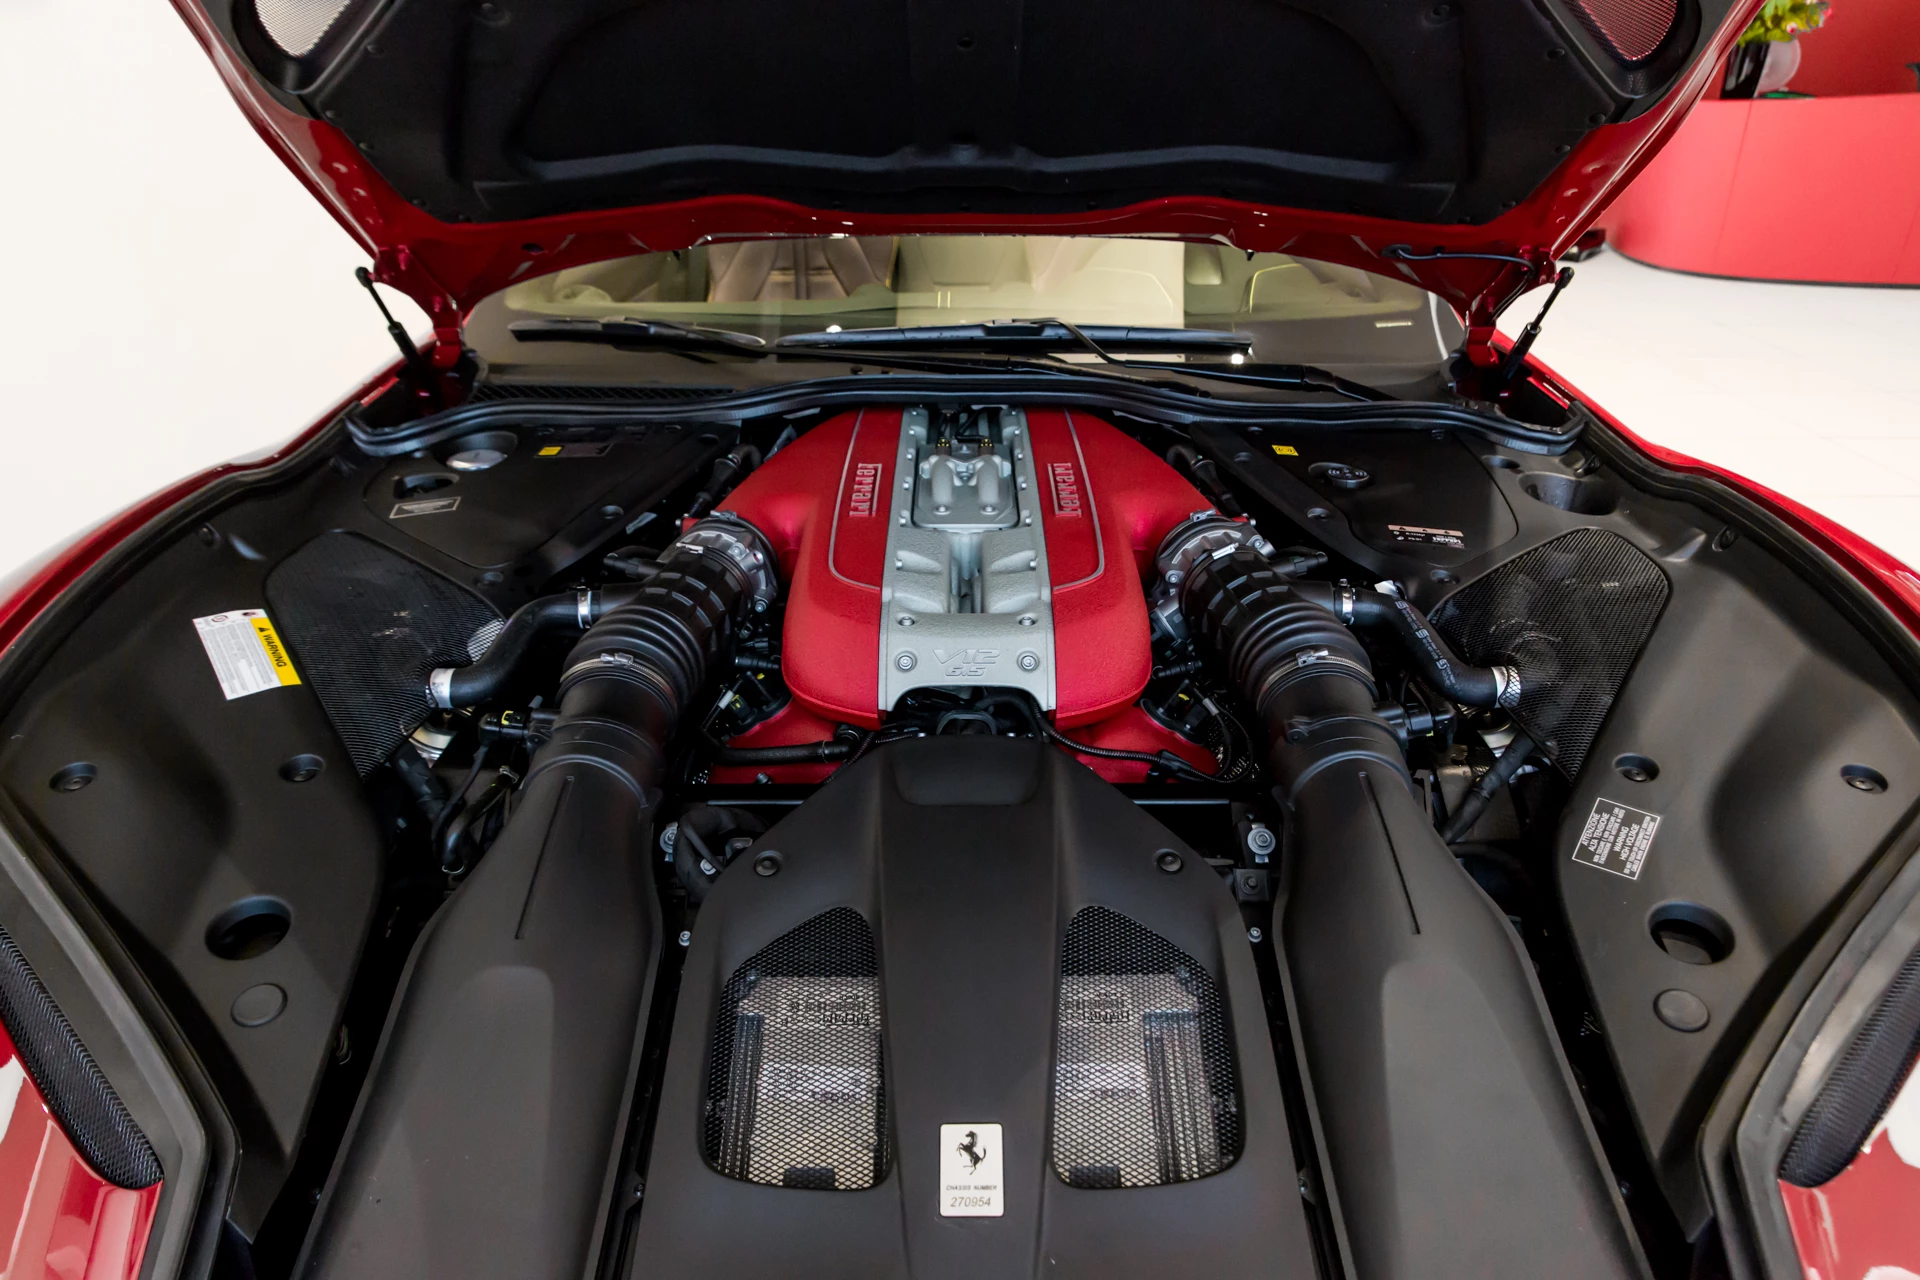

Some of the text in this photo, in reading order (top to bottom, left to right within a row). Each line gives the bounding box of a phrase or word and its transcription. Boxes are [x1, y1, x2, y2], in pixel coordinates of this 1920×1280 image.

[850, 463, 882, 516] Ferrari
[1047, 462, 1081, 517] Ferrari
[263, 634, 287, 667] WARNING
[933, 649, 1000, 664] V12
[945, 666, 986, 676] 6.5
[1581, 812, 1601, 846] ATTENZIONE
[1593, 812, 1610, 838] TENSIONE
[1613, 825, 1629, 852] WARNING
[1588, 839, 1599, 852] ALTA
[1619, 845, 1631, 860] HIGH
[1627, 823, 1640, 847] VOLTAGE
[950, 1197, 991, 1207] 270954
